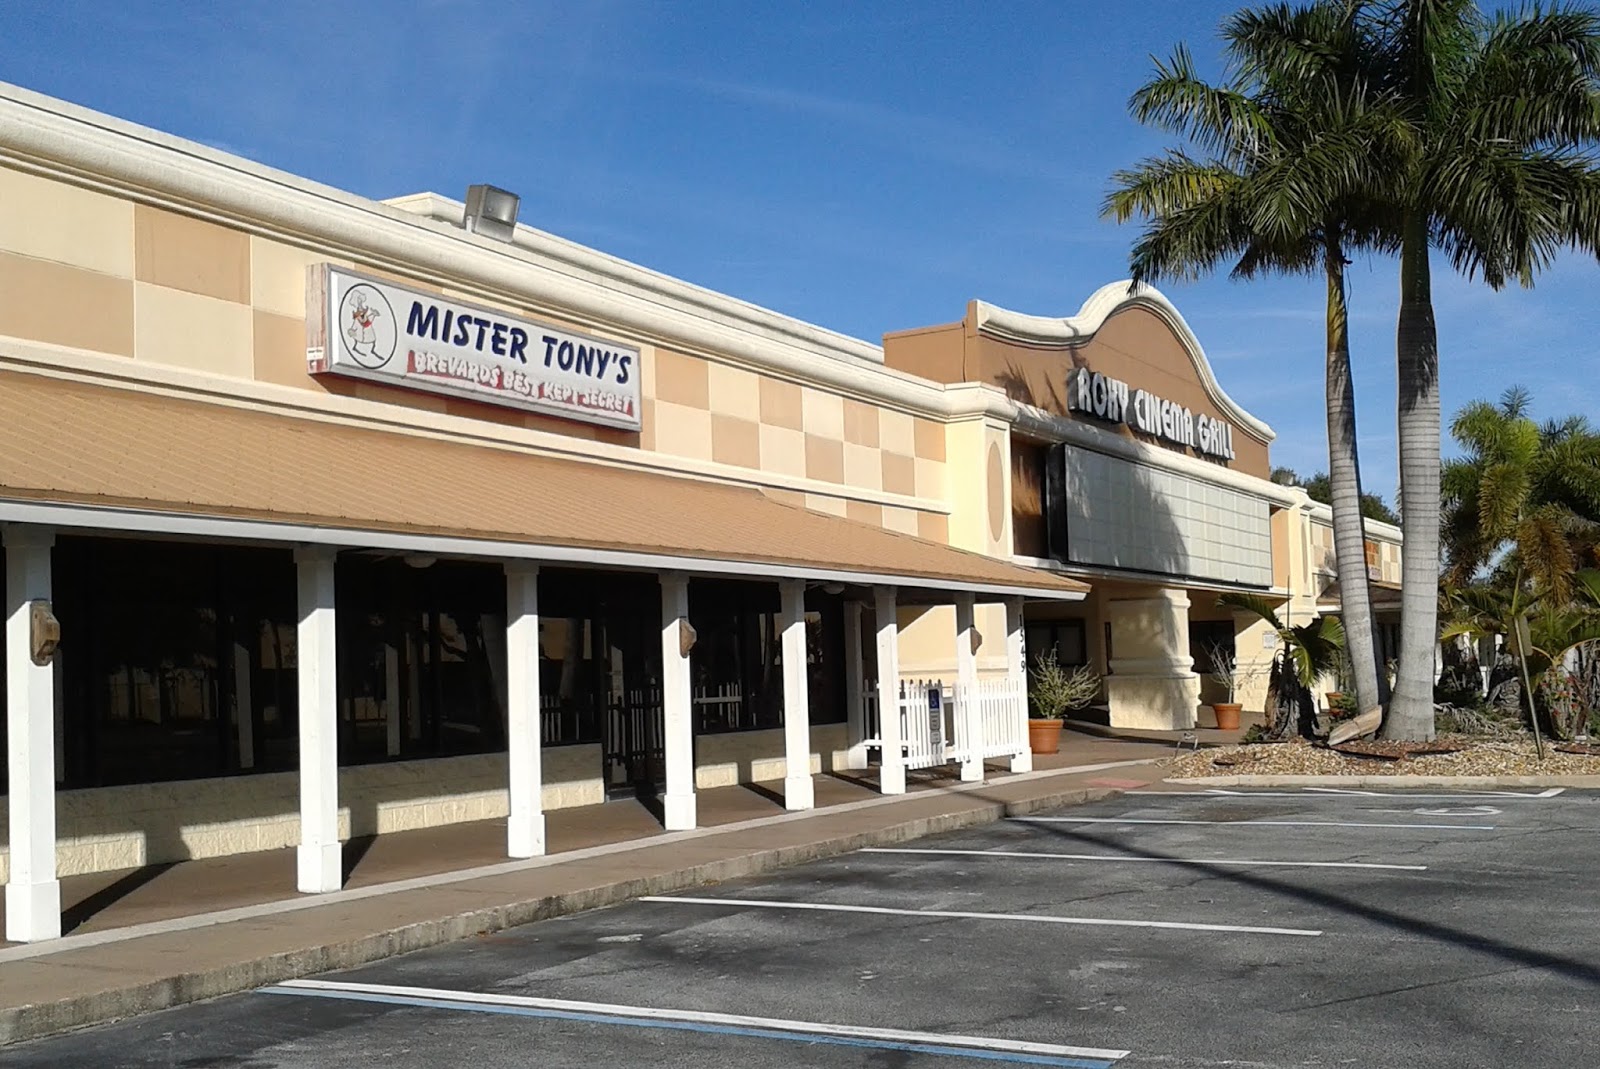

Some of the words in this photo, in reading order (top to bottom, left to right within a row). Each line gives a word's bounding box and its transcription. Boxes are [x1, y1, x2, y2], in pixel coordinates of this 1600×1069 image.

[406, 301, 529, 364] MISTER
[543, 335, 631, 384] TONY'S
[503, 370, 539, 399] BEST
[544, 381, 579, 406] KEPT
[582, 392, 634, 413] SECRET
[1075, 367, 1129, 422] ROXY
[1134, 389, 1197, 447] CINEMA
[1197, 413, 1236, 460] GRILL
